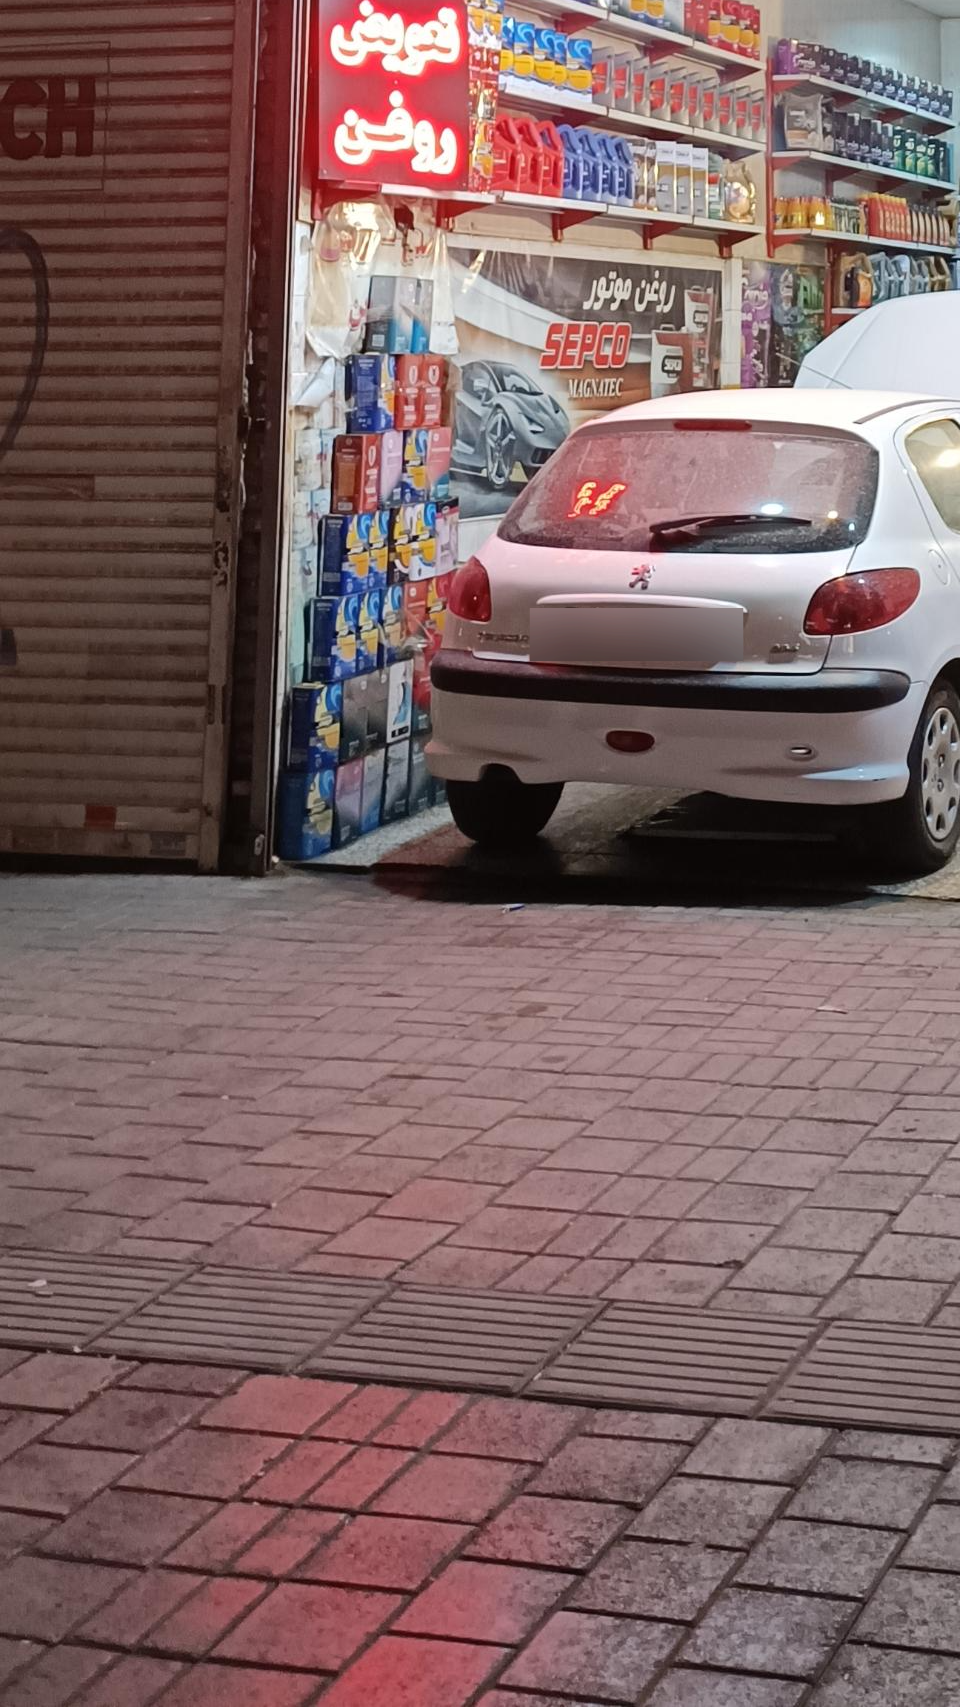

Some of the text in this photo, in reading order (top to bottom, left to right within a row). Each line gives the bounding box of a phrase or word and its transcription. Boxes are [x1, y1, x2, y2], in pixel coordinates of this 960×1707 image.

[330, 0, 460, 76] تعویض
[334, 90, 457, 174] روغن
[583, 270, 676, 313] روغن موتور
[540, 322, 632, 369] SEPCO
[568, 377, 625, 398] MAGNATEC
